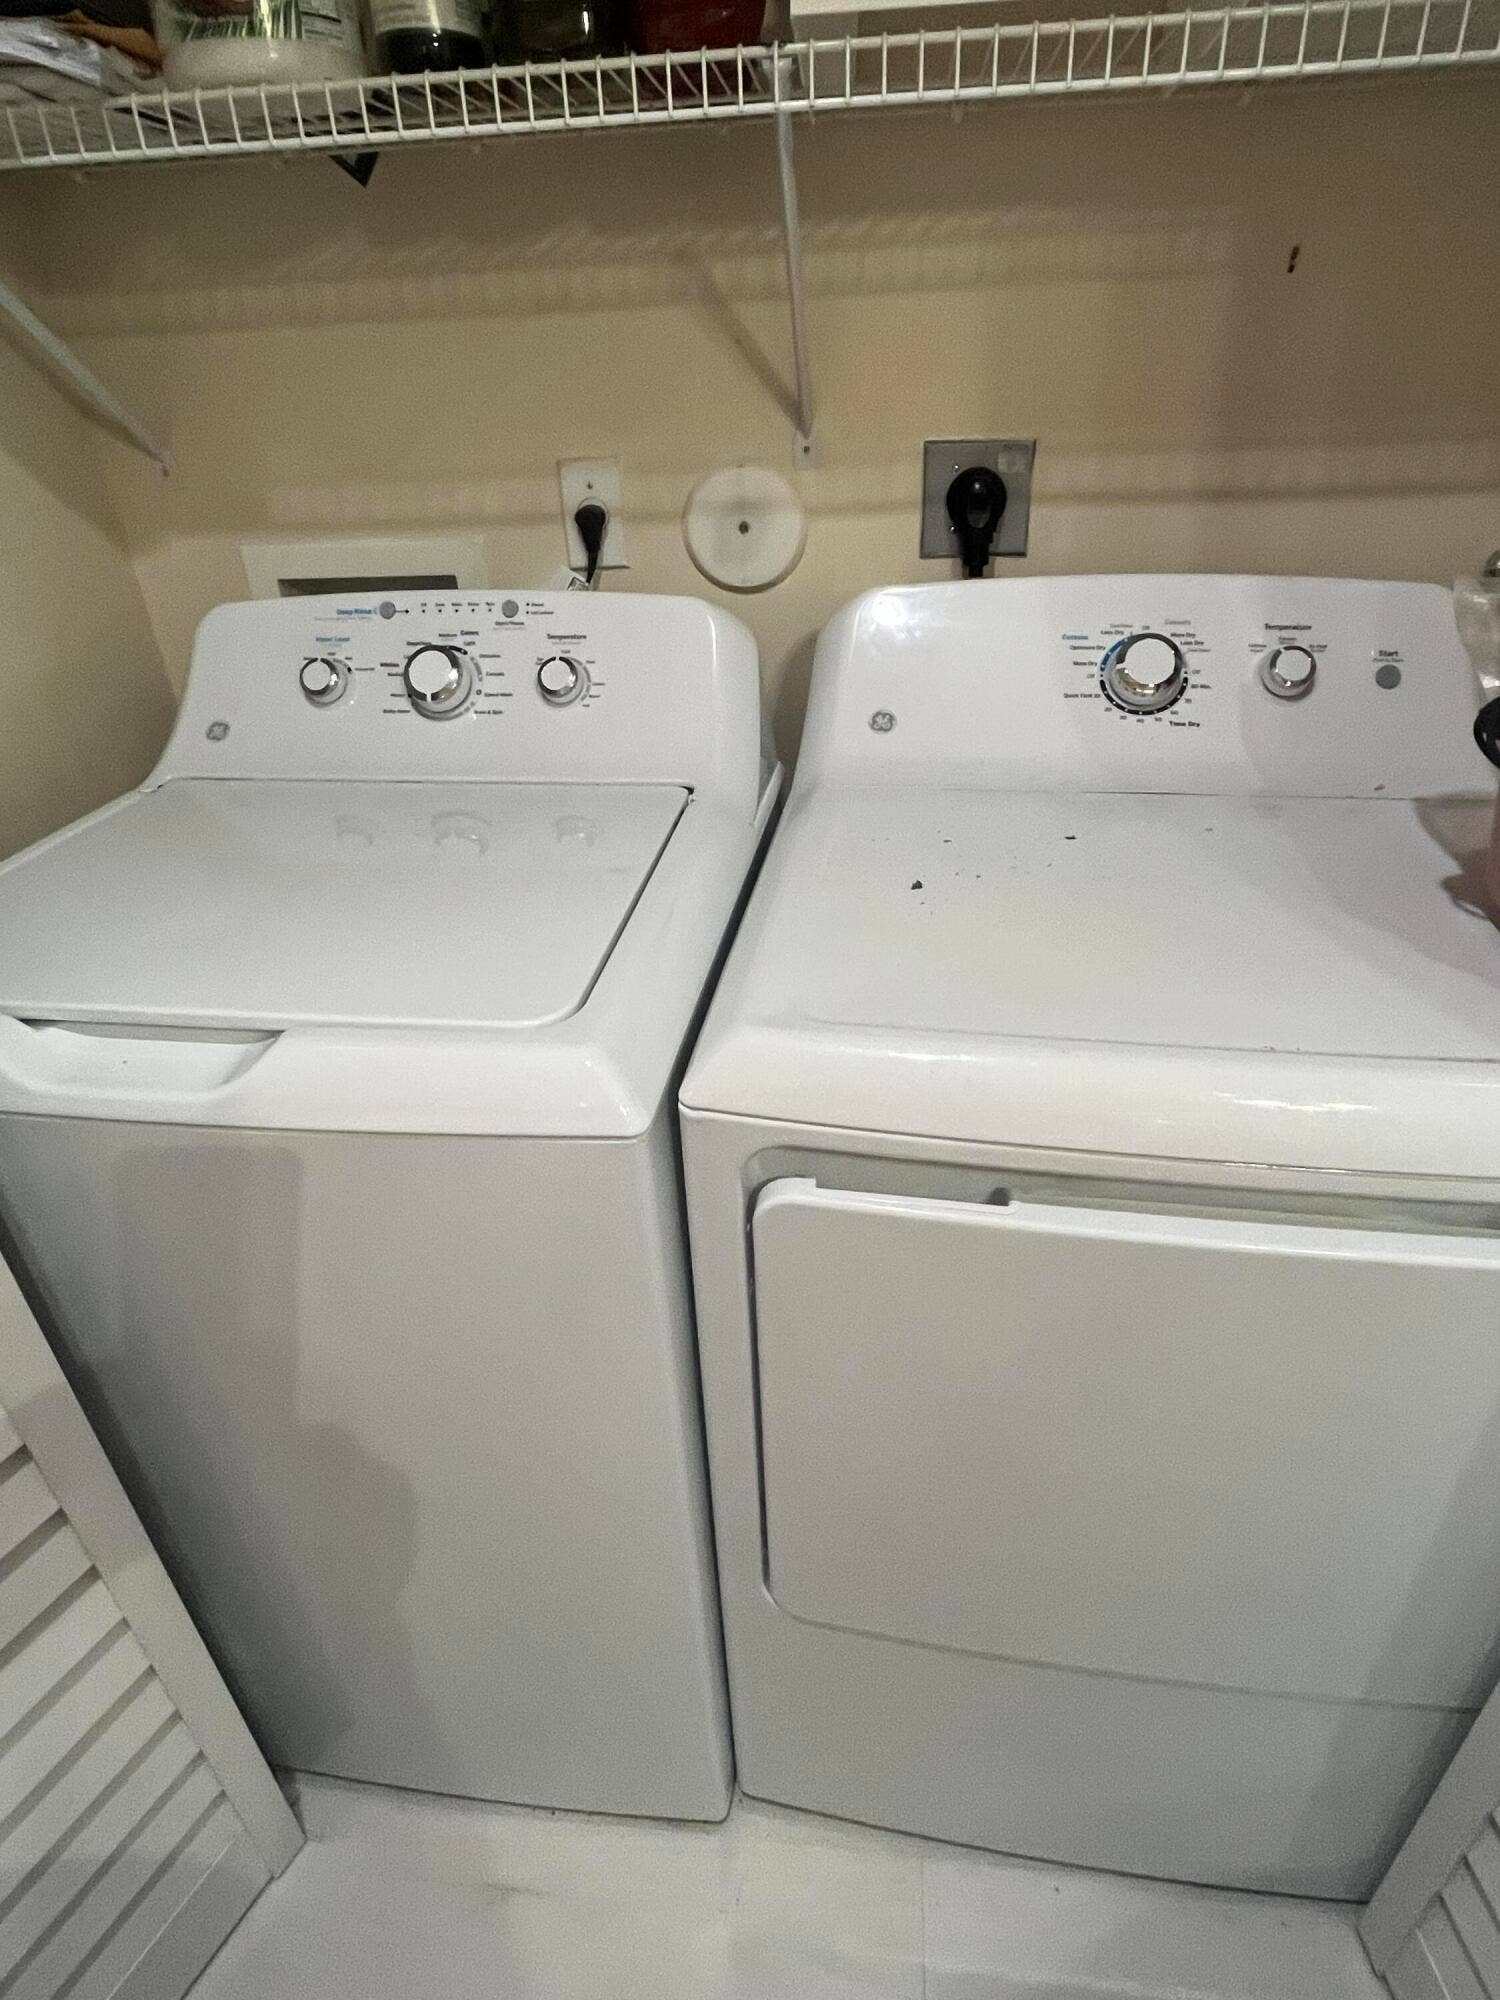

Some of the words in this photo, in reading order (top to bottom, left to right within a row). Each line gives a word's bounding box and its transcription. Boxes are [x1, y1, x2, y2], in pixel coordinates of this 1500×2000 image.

[1264, 623, 1313, 632] Temperature
[546, 632, 587, 642] Temperature
[1378, 650, 1400, 658] Start
